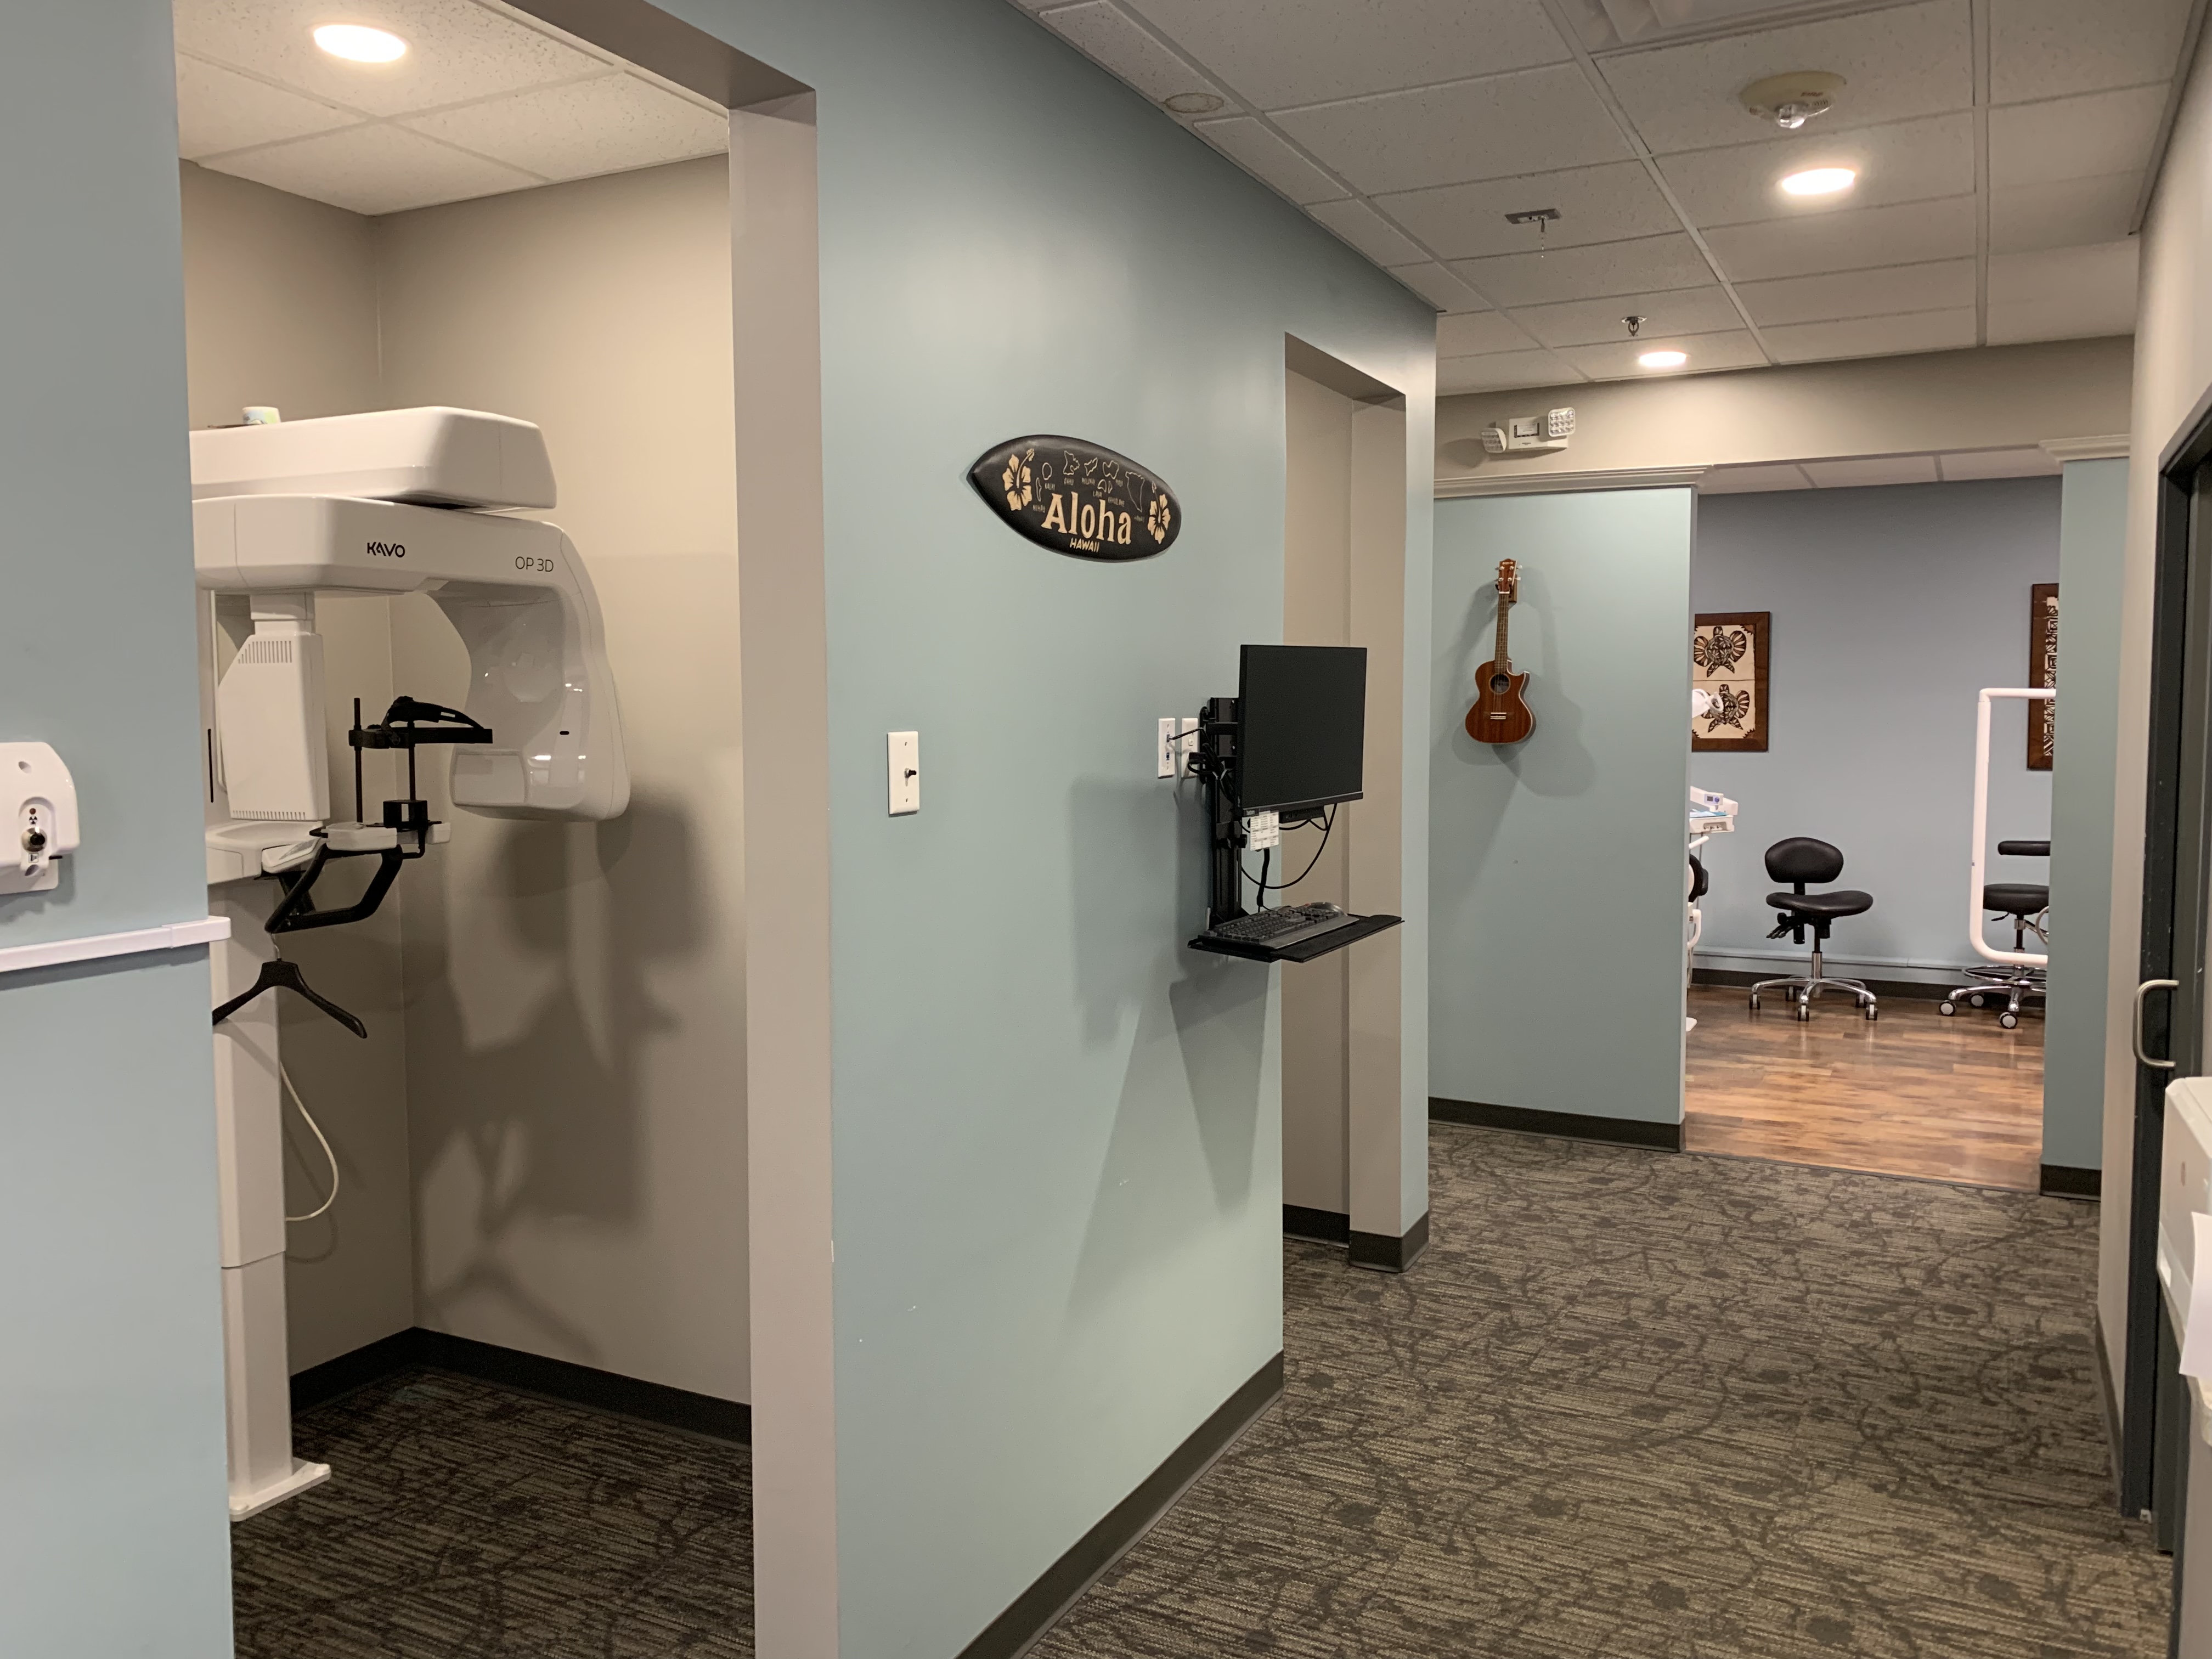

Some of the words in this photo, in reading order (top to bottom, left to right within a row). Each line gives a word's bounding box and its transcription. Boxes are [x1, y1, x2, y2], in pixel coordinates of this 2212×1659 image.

[1041, 491, 1131, 544] Aloha
[367, 541, 405, 558] KAVO
[1070, 538, 1100, 553] HAWAII
[515, 556, 534, 570] OP
[537, 558, 554, 572] 3D
